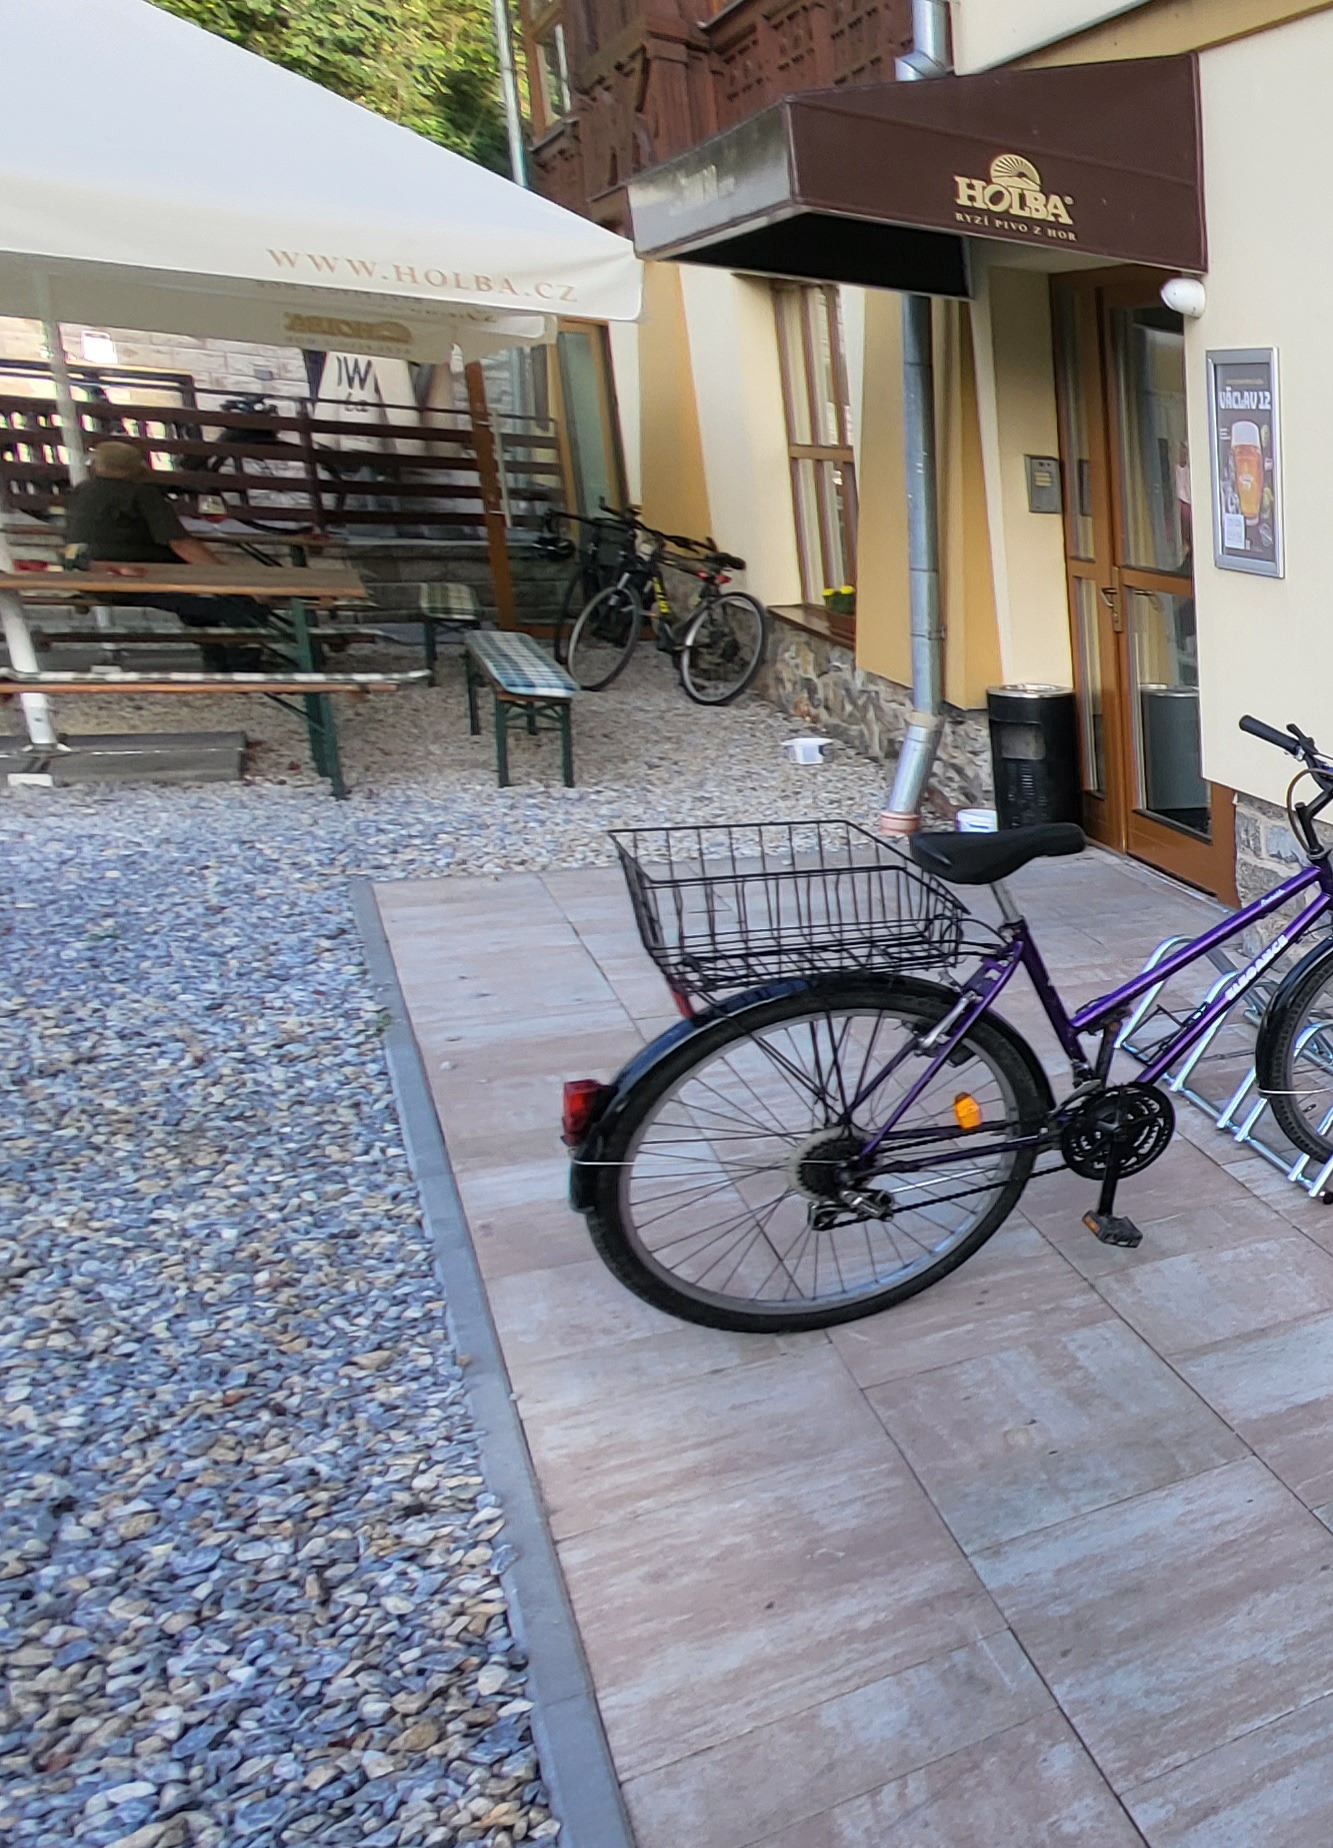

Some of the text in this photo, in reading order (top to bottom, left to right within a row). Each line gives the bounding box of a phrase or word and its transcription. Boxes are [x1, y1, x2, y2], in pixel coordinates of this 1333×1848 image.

[953, 174, 1073, 225] HOLBA
[955, 212, 1077, 241] RYZÍ PIVO Z HOR
[266, 248, 578, 302] WWW.HOLBA.CZ
[1218, 386, 1271, 410] VÁCLAV 12
